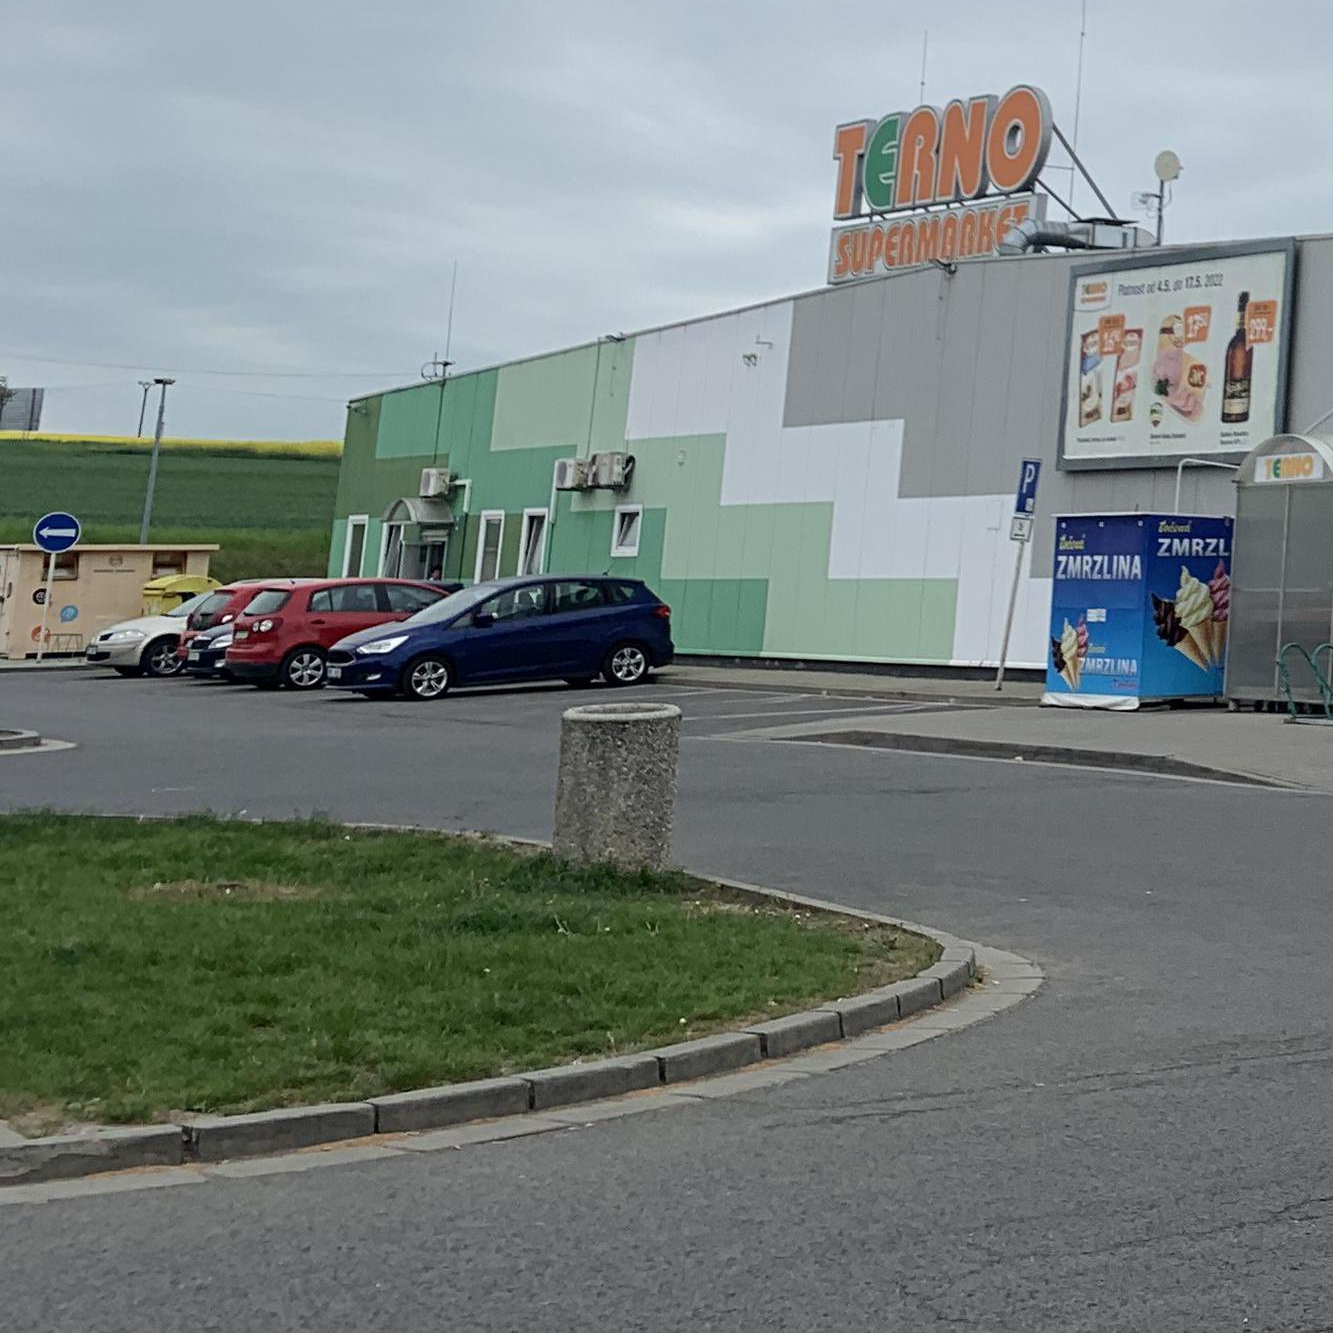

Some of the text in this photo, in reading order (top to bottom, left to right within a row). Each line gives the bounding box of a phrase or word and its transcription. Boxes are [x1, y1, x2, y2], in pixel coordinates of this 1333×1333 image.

[833, 85, 1051, 220] TERNO
[1022, 463, 1036, 494] P
[1264, 454, 1315, 479] TERNO
[1156, 538, 1230, 557] ZMRZL
[1056, 554, 1142, 580] ZMRZLINA
